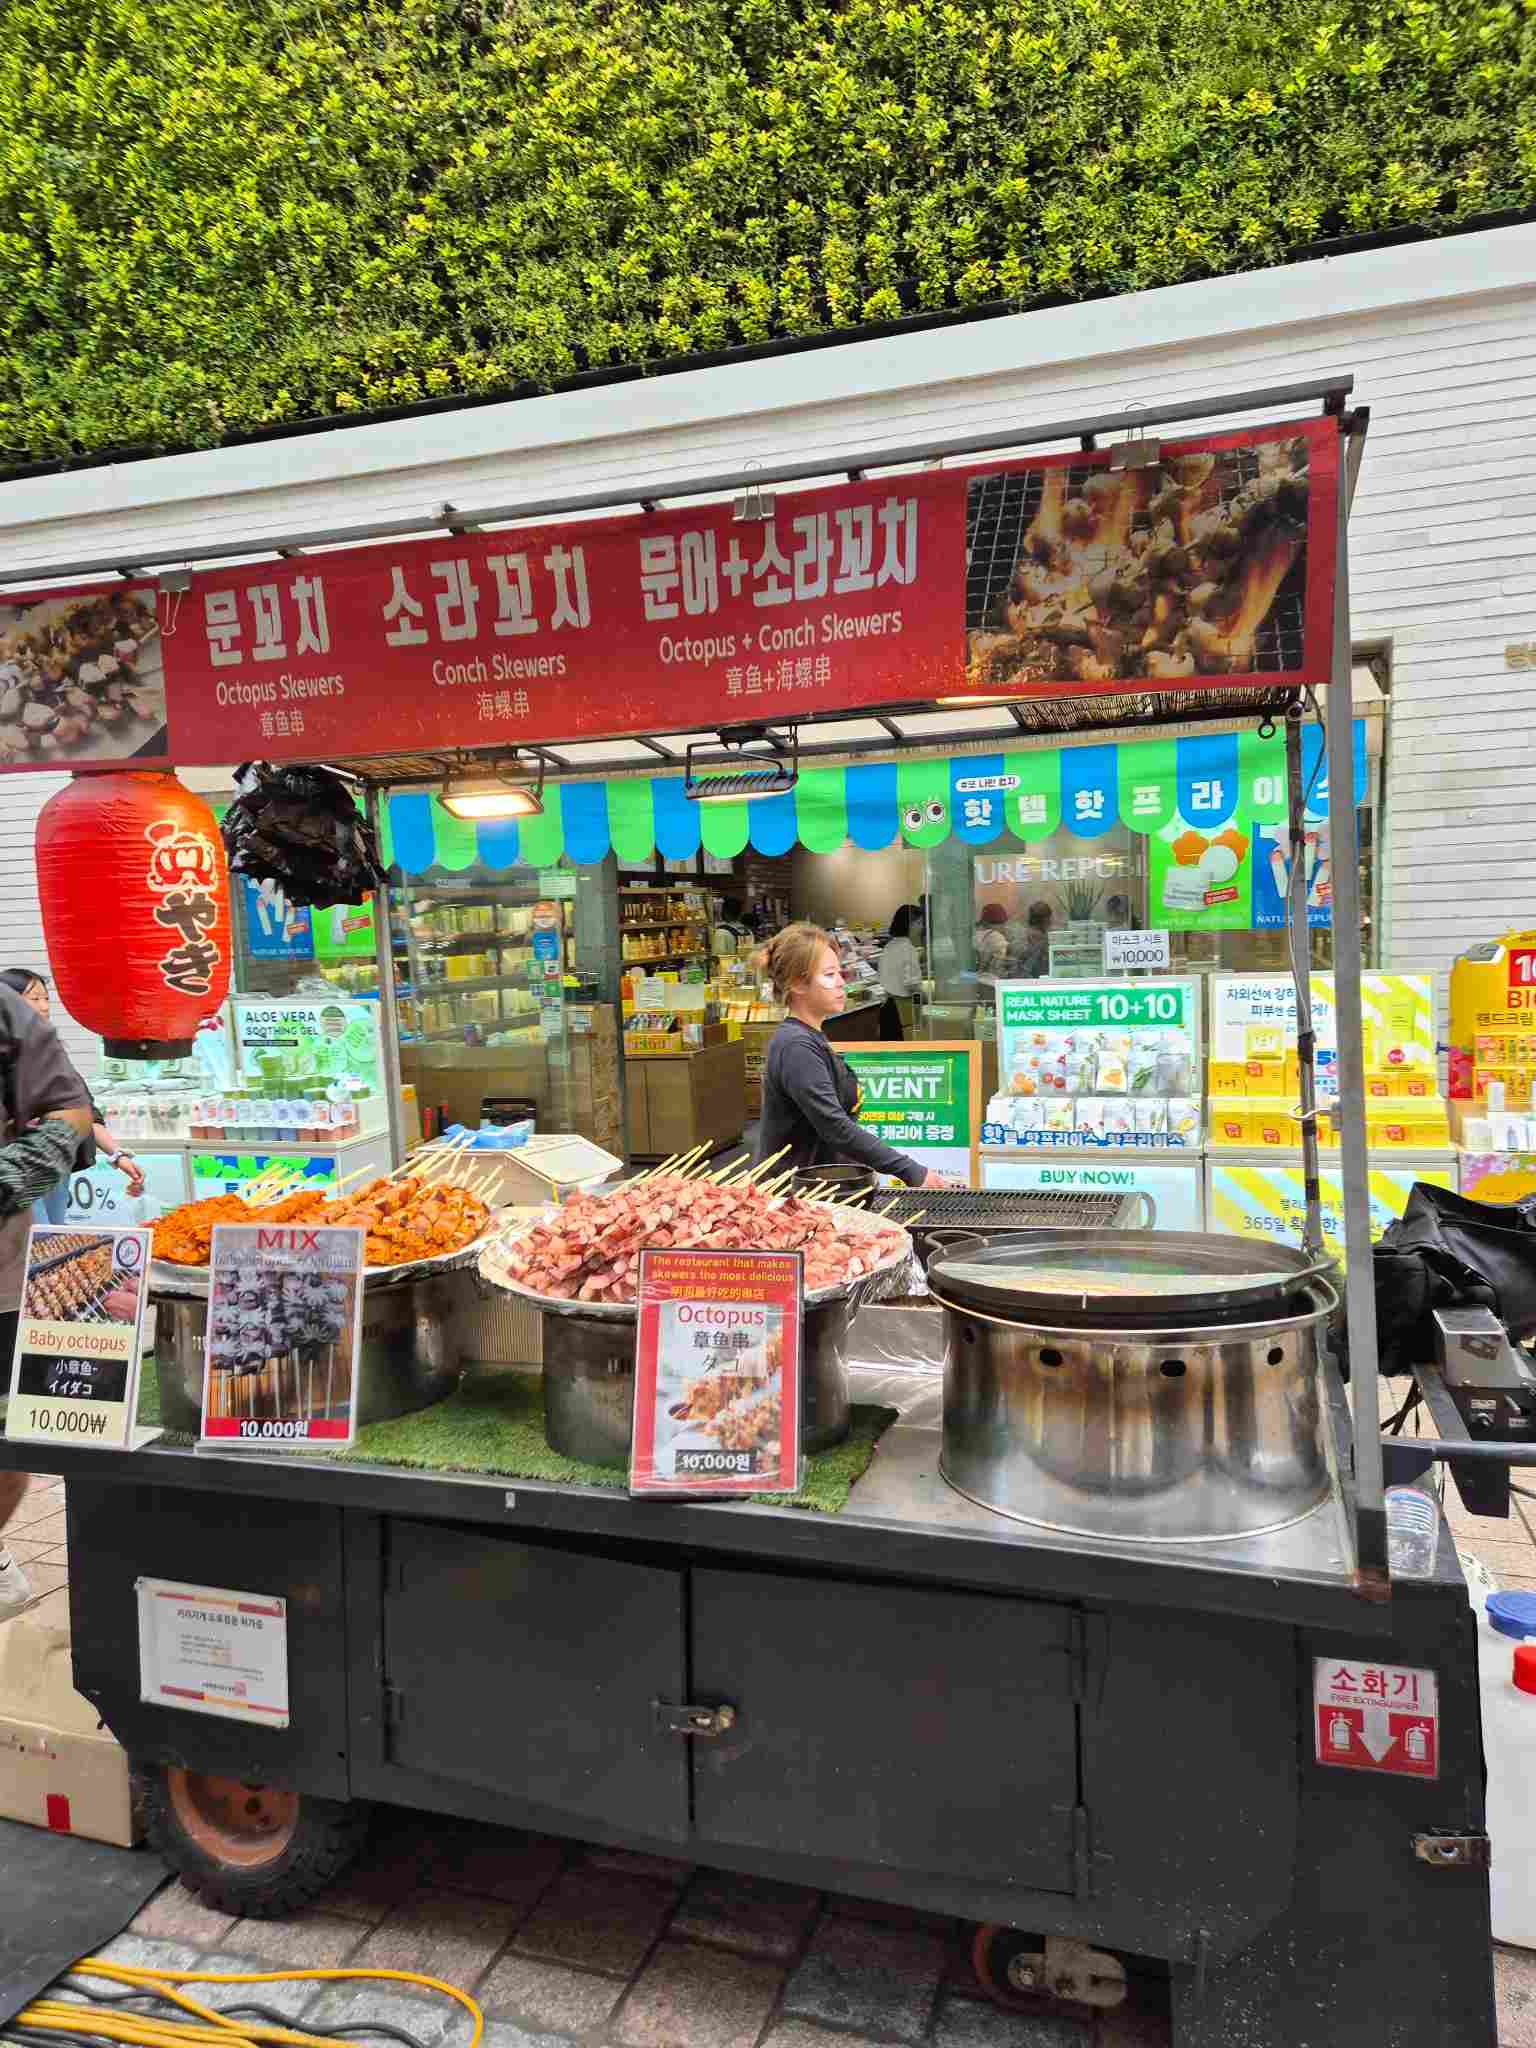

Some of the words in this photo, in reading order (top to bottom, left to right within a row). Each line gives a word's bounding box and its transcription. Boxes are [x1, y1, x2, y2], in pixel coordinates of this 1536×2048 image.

[640, 497, 918, 621] 문어+소라꼬치
[383, 545, 592, 647] 소라꼬치
[204, 576, 331, 666] 문꼬치
[660, 634, 736, 665] Octopus
[742, 635, 753, 649] +
[759, 625, 816, 651] Conch
[822, 609, 903, 643] Skewers
[432, 658, 488, 685] Conch
[492, 653, 566, 681] Skewers
[726, 655, 831, 697] 章鱼+海螺串
[216, 679, 277, 711] Octopus
[279, 673, 345, 698] Skewers
[477, 688, 531, 721] 海螺串
[259, 711, 305, 741] 章鱼串
[245, 1011, 277, 1022] ALOE
[279, 1011, 316, 1022] VERA
[1006, 996, 1038, 1006] REAL
[1040, 994, 1092, 1006] NATURE
[1097, 993, 1176, 1020] 10+10
[1007, 1010, 1044, 1021] MASK
[1044, 1009, 1092, 1021] SHEET
[1039, 1170, 1078, 1184] BUY
[1082, 1170, 1136, 1186] NOW!
[256, 1229, 321, 1250] MIX
[652, 1255, 672, 1266] The
[719, 1271, 747, 1281] most
[677, 1304, 765, 1328] Octopus
[29, 1329, 64, 1349] Baby
[67, 1333, 127, 1353] octopus
[48, 1380, 93, 1395] イイダコ
[1328, 1666, 1419, 1702] 소화기
